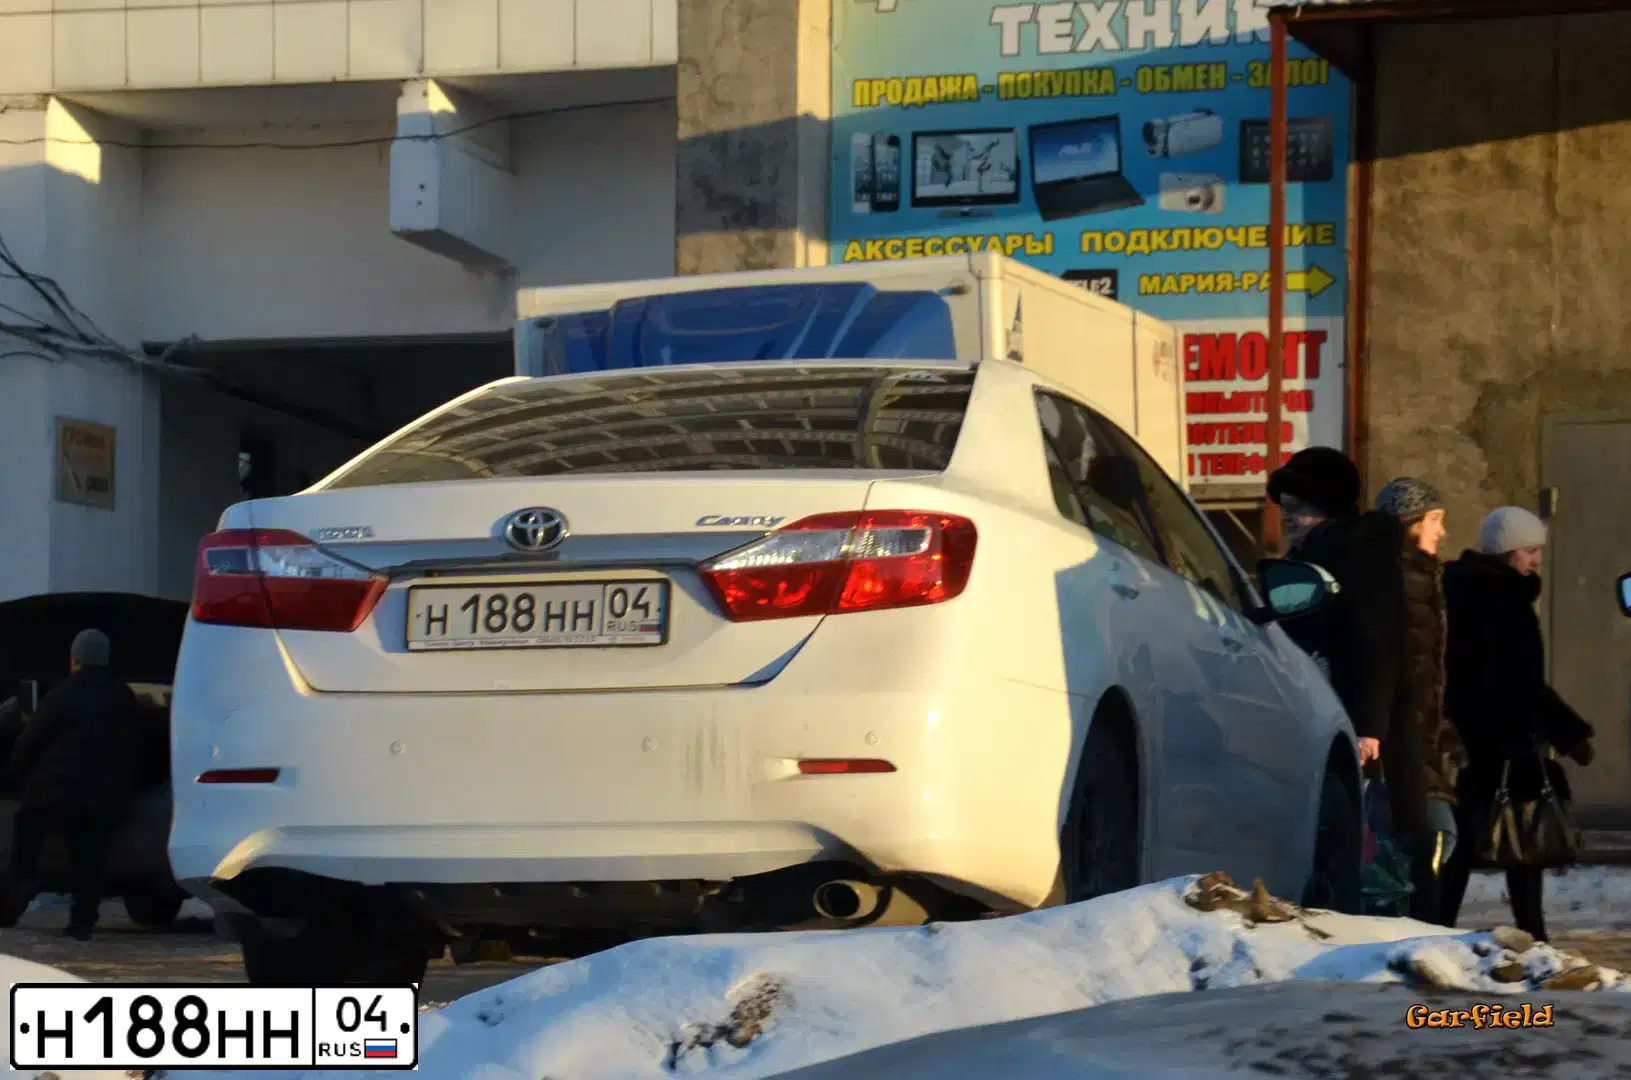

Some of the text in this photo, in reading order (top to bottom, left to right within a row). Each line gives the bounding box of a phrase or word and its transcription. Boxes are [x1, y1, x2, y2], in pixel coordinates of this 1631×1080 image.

[853, 75, 977, 107] ПРОДАЖА
[998, 68, 1115, 98] ПОКУПКА
[1136, 61, 1226, 93] ОБМЕН
[843, 232, 1054, 262] АКСЕССУАРЫ
[609, 586, 650, 619] 04
